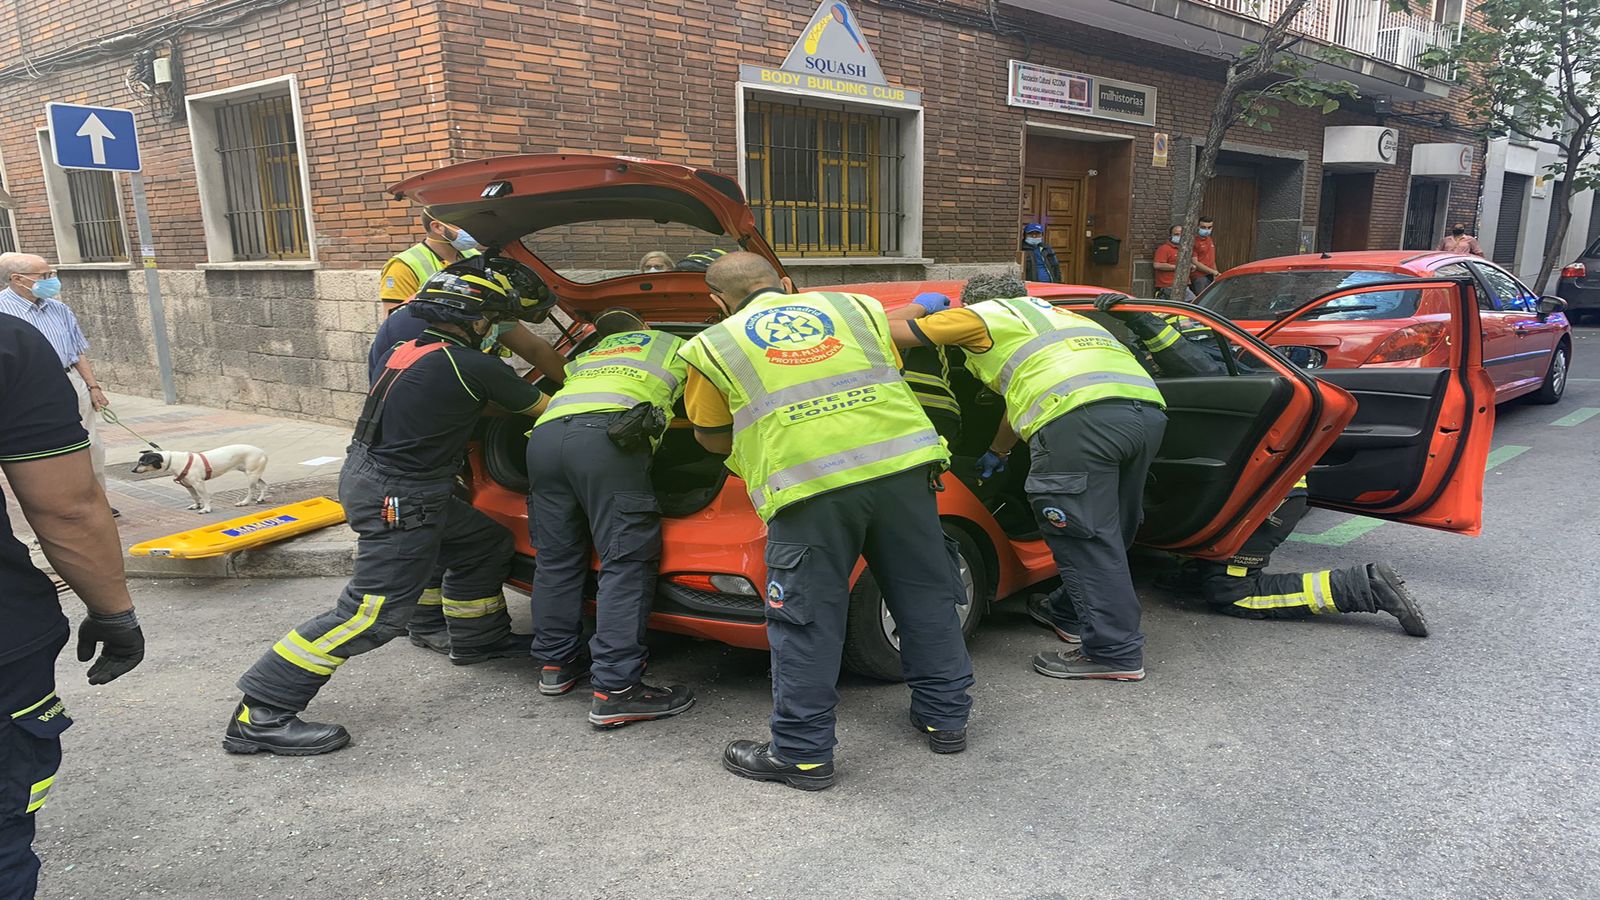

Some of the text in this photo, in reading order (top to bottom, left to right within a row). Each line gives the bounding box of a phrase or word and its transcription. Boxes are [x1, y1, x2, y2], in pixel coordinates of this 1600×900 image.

[805, 56, 867, 78] SQUASH
[761, 69, 905, 101] BODY BUILDING CLUB
[1101, 90, 1144, 106] milhistorias
[786, 307, 822, 317] madrid
[784, 386, 877, 414] JEFE DE
[789, 395, 877, 421] EQUIPO
